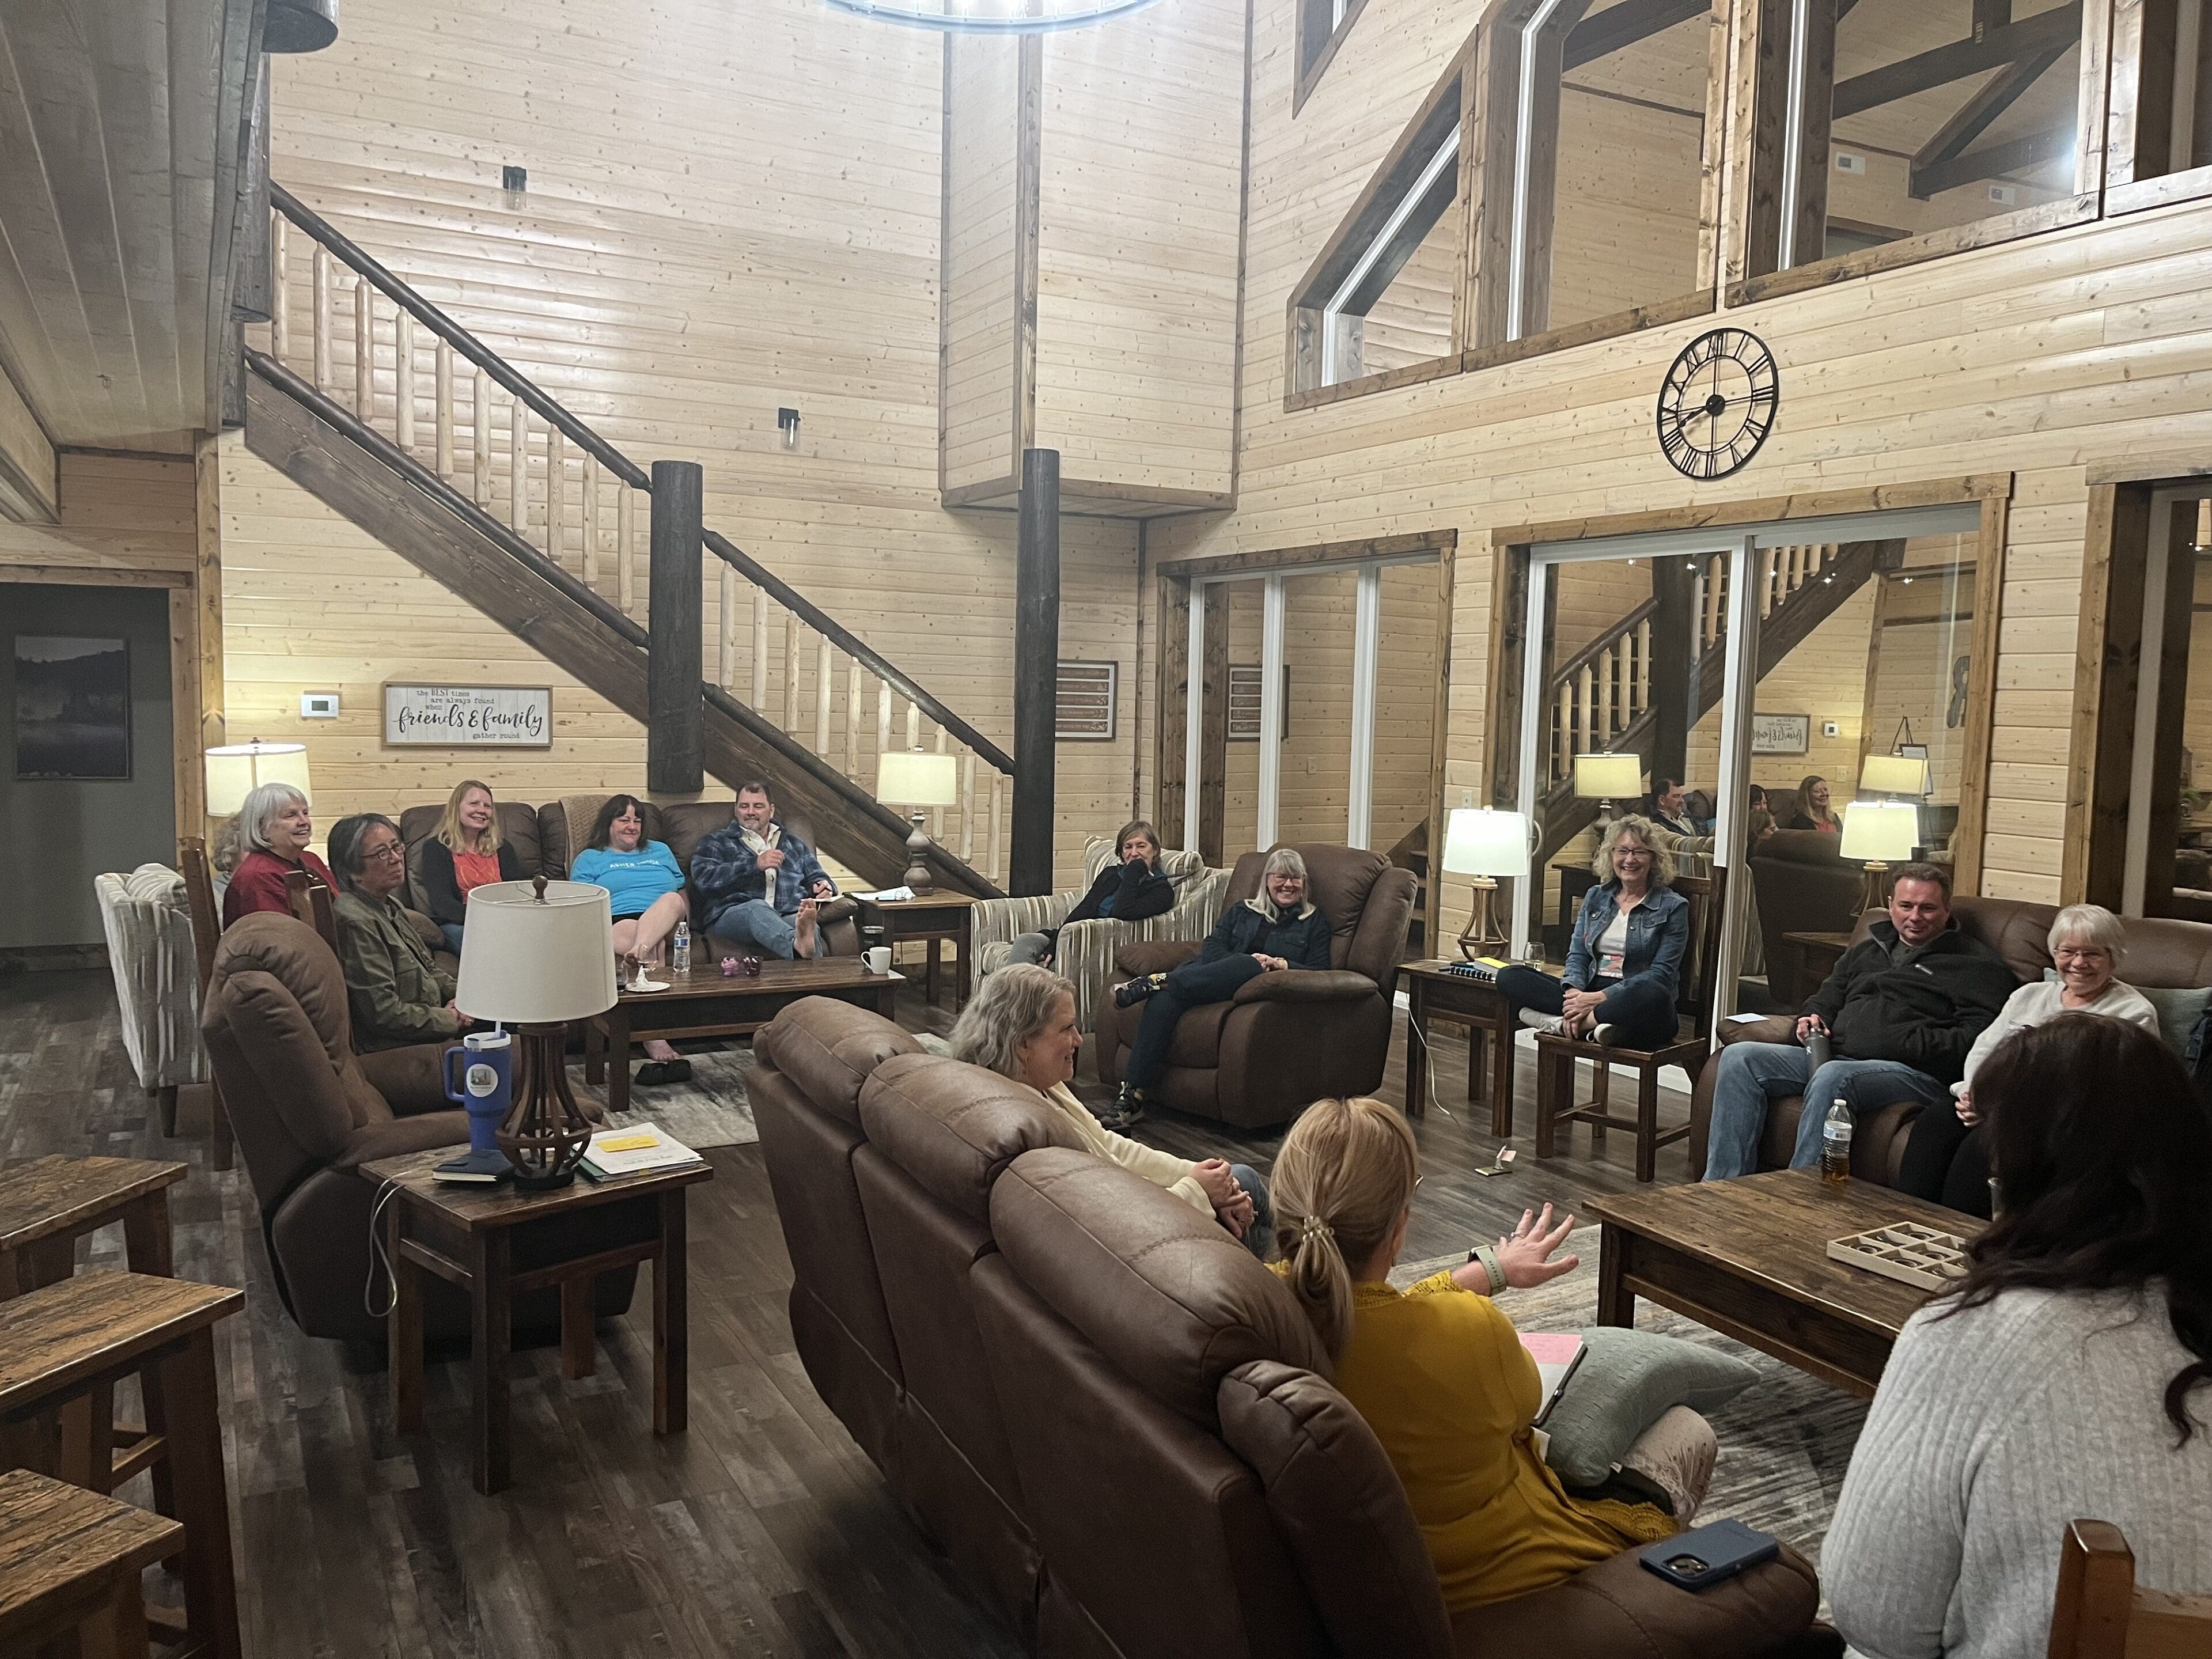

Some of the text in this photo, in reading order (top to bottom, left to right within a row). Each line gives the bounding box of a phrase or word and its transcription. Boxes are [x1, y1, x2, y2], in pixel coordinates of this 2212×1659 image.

[392, 704, 543, 737] friends & family
